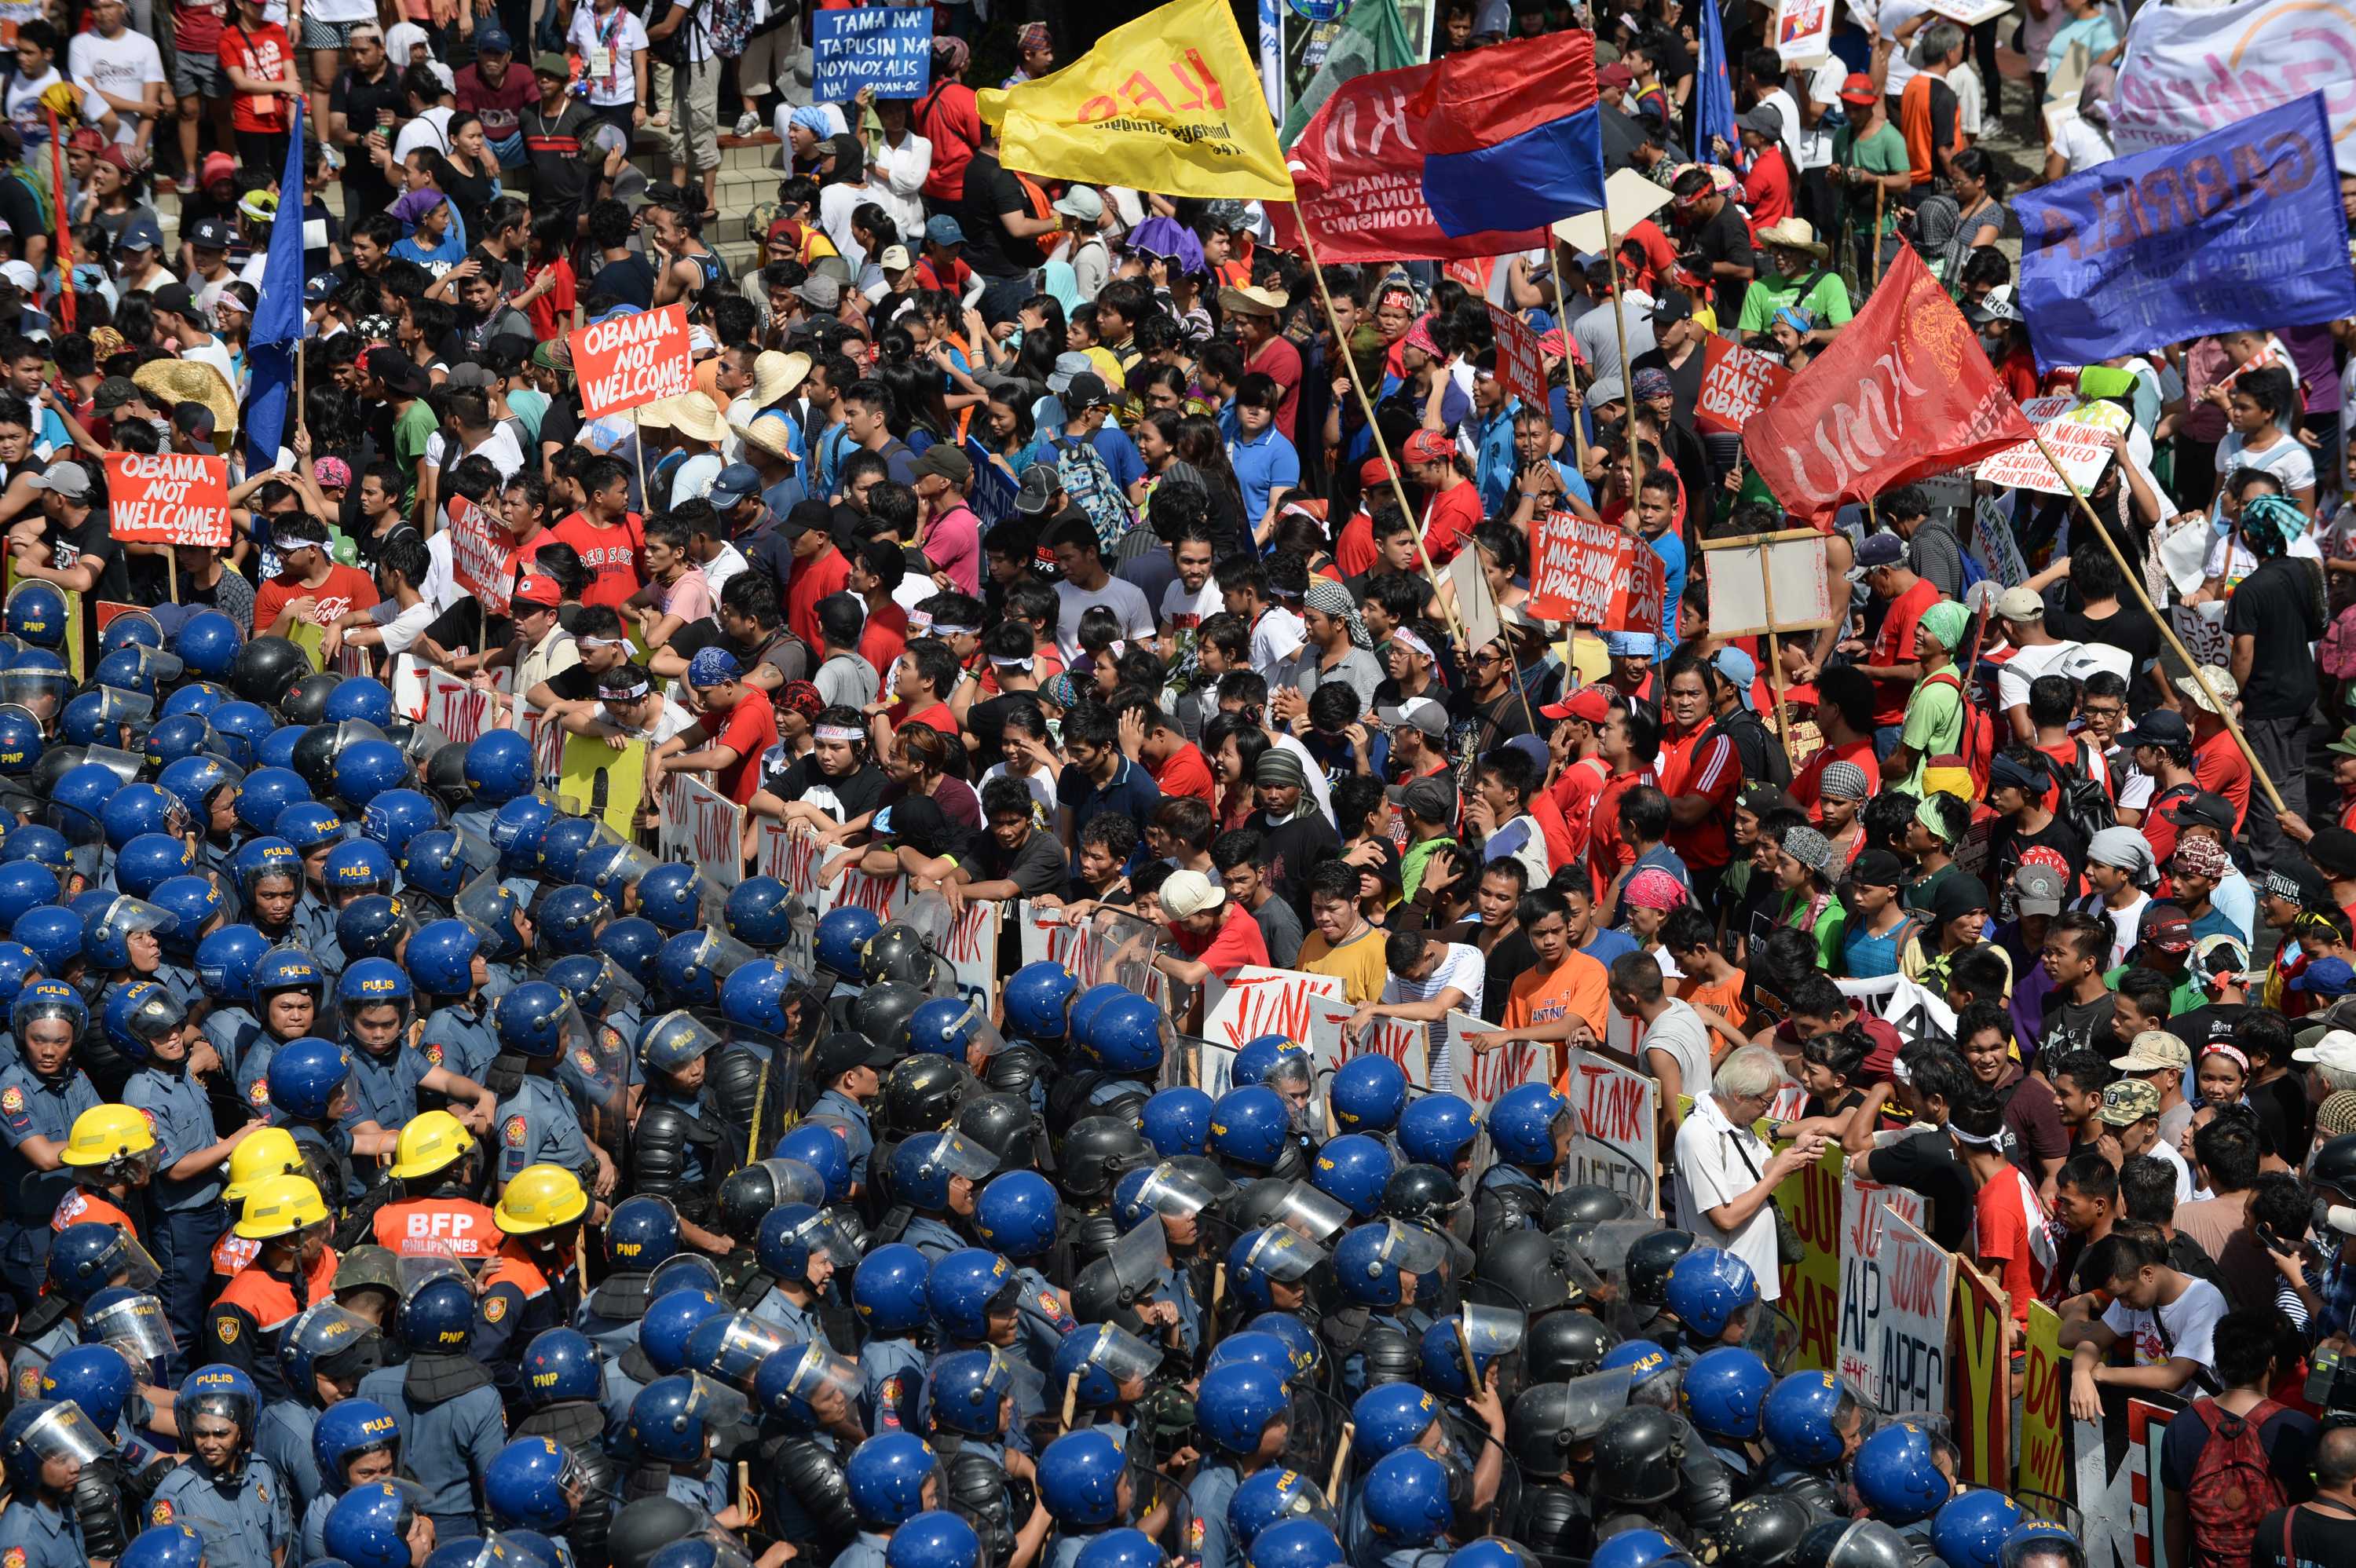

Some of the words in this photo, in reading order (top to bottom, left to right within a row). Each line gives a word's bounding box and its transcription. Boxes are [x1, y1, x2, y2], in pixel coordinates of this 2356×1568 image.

[833, 14, 887, 35] TAMA
[893, 11, 922, 30] NA!
[820, 38, 898, 59] TAPUSIN
[902, 37, 930, 58] NA!
[884, 60, 918, 77] ALIS
[822, 81, 848, 97] NA!
[613, 339, 661, 372] NOT
[586, 349, 693, 412] WELCOME!
[1705, 366, 1762, 406] ATAKE
[1702, 389, 1763, 425] OBRE
[2025, 398, 2071, 418] FIGHT
[121, 454, 218, 486] OBAMA,
[142, 480, 192, 504] NOT
[113, 499, 227, 535] WELCOME!
[166, 532, 231, 546] -KMU-
[1546, 511, 1617, 550] KARAPATANG
[609, 546, 635, 566] SOX
[24, 621, 46, 632] PNP
[2178, 612, 2204, 667] FIGH
[437, 684, 487, 743] JUNK
[2, 752, 24, 764] PNP
[316, 818, 341, 834] PULIS
[693, 794, 734, 864] JUNK
[264, 846, 294, 857] PULIS
[339, 865, 371, 877] PULIS
[280, 965, 311, 976] PULIS
[38, 985, 71, 996] PULIS
[363, 979, 395, 992] PULIS
[1325, 1013, 1414, 1089] JUNK
[1458, 1030, 1537, 1103] JUNK
[1578, 1063, 1644, 1143] JUNK
[1340, 1111, 1359, 1124] PNP
[1211, 1122, 1227, 1136] PNP
[1318, 1157, 1334, 1171] PNP
[408, 1213, 474, 1238] BFP
[616, 1243, 642, 1256] PNP
[1887, 1230, 1941, 1320] JUNK
[1841, 1257, 1879, 1348] AP
[440, 1331, 465, 1343] PNP
[1632, 1352, 1663, 1375] PULIS
[197, 1372, 234, 1386] PULIS
[533, 1372, 558, 1387] PNP
[365, 1416, 394, 1435] PULIS
